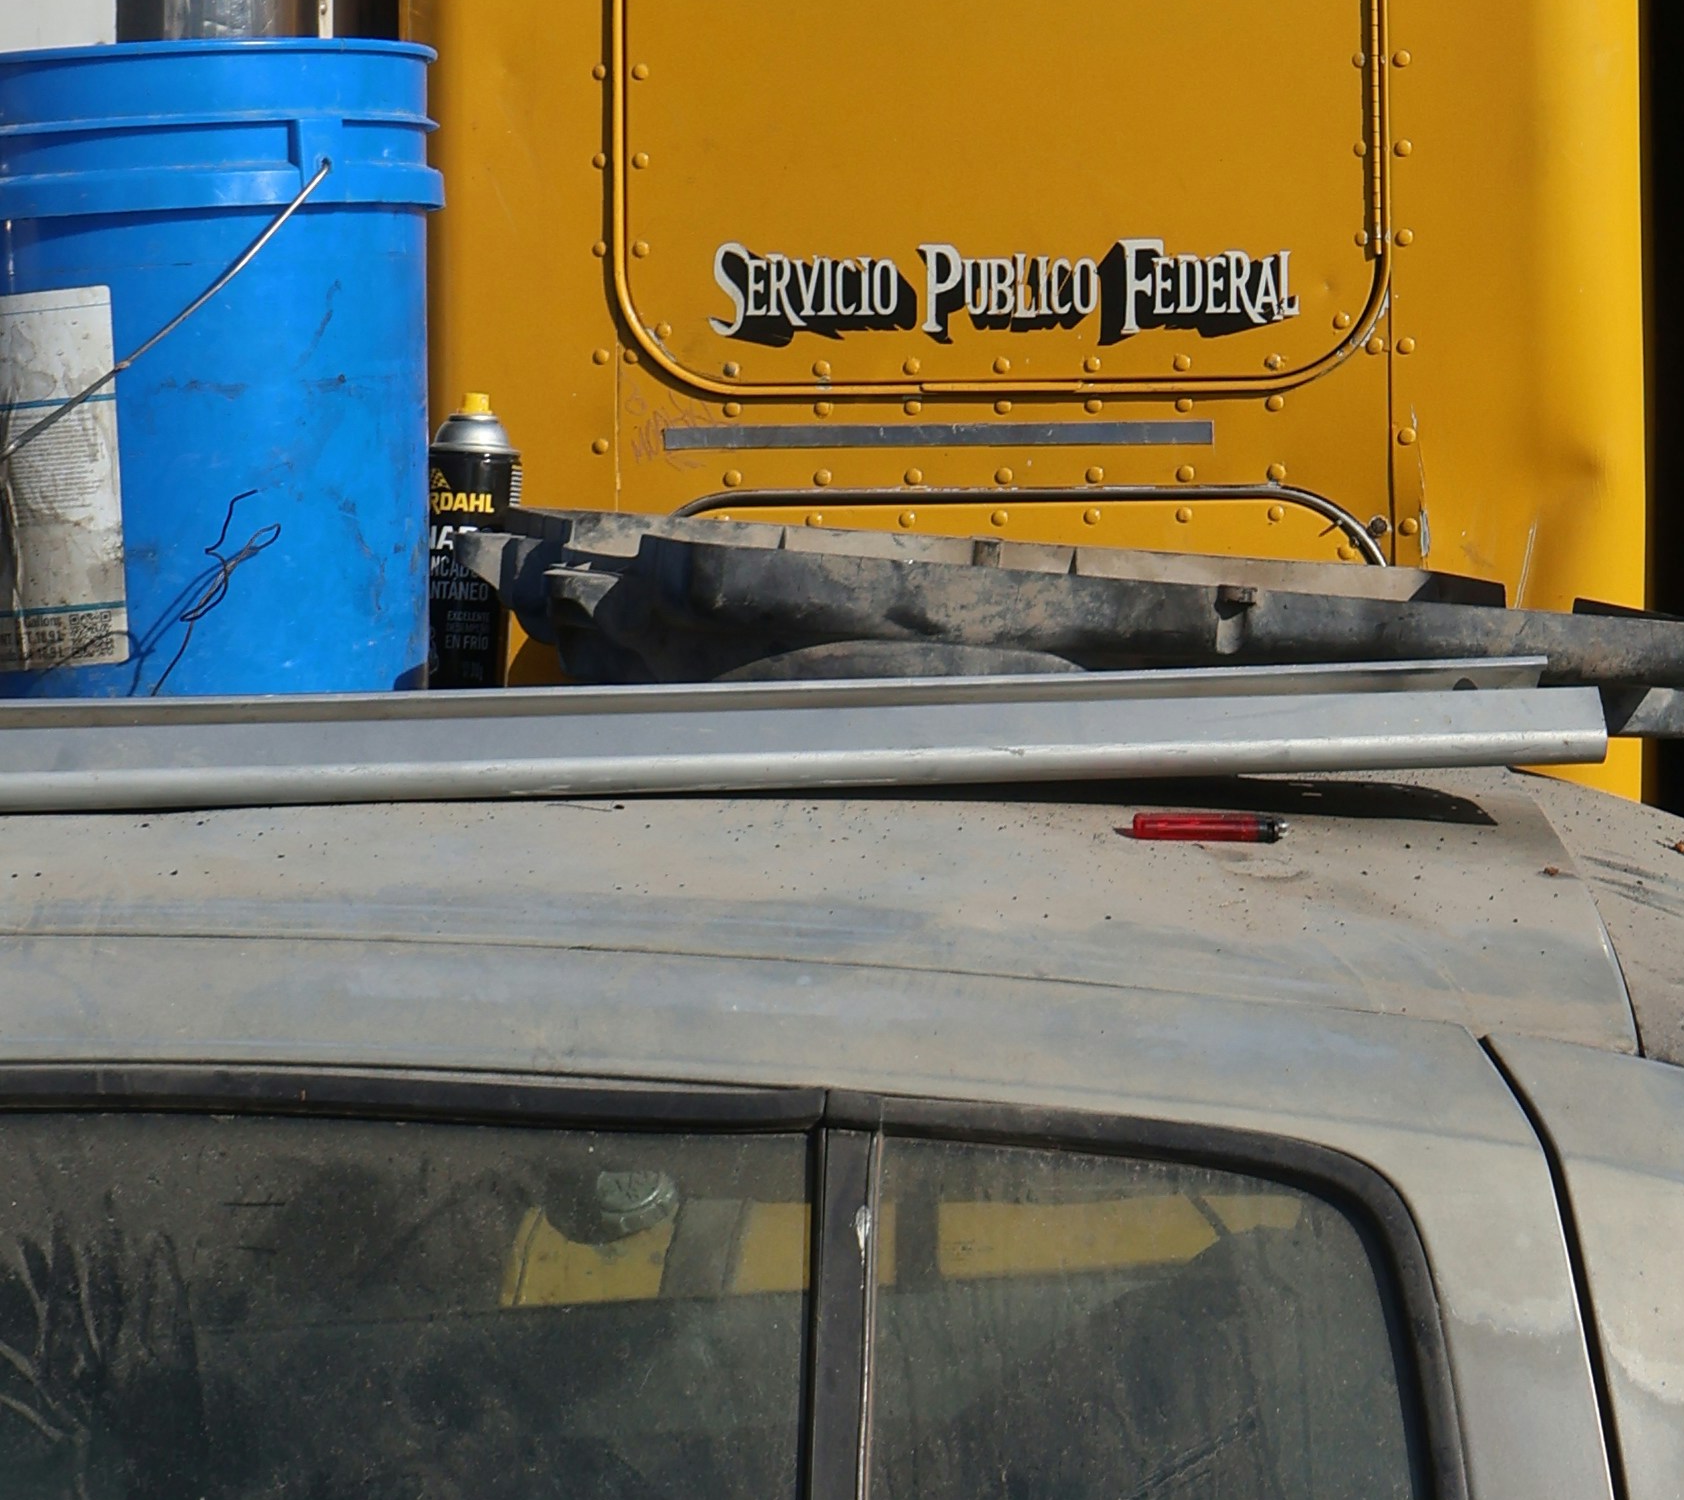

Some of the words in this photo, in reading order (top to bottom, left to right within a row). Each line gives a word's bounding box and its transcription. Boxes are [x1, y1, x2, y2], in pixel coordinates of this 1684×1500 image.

[708, 241, 900, 338] SERVICIO
[919, 242, 1099, 335] PUBLICO
[1117, 238, 1300, 336] FEDERAL
